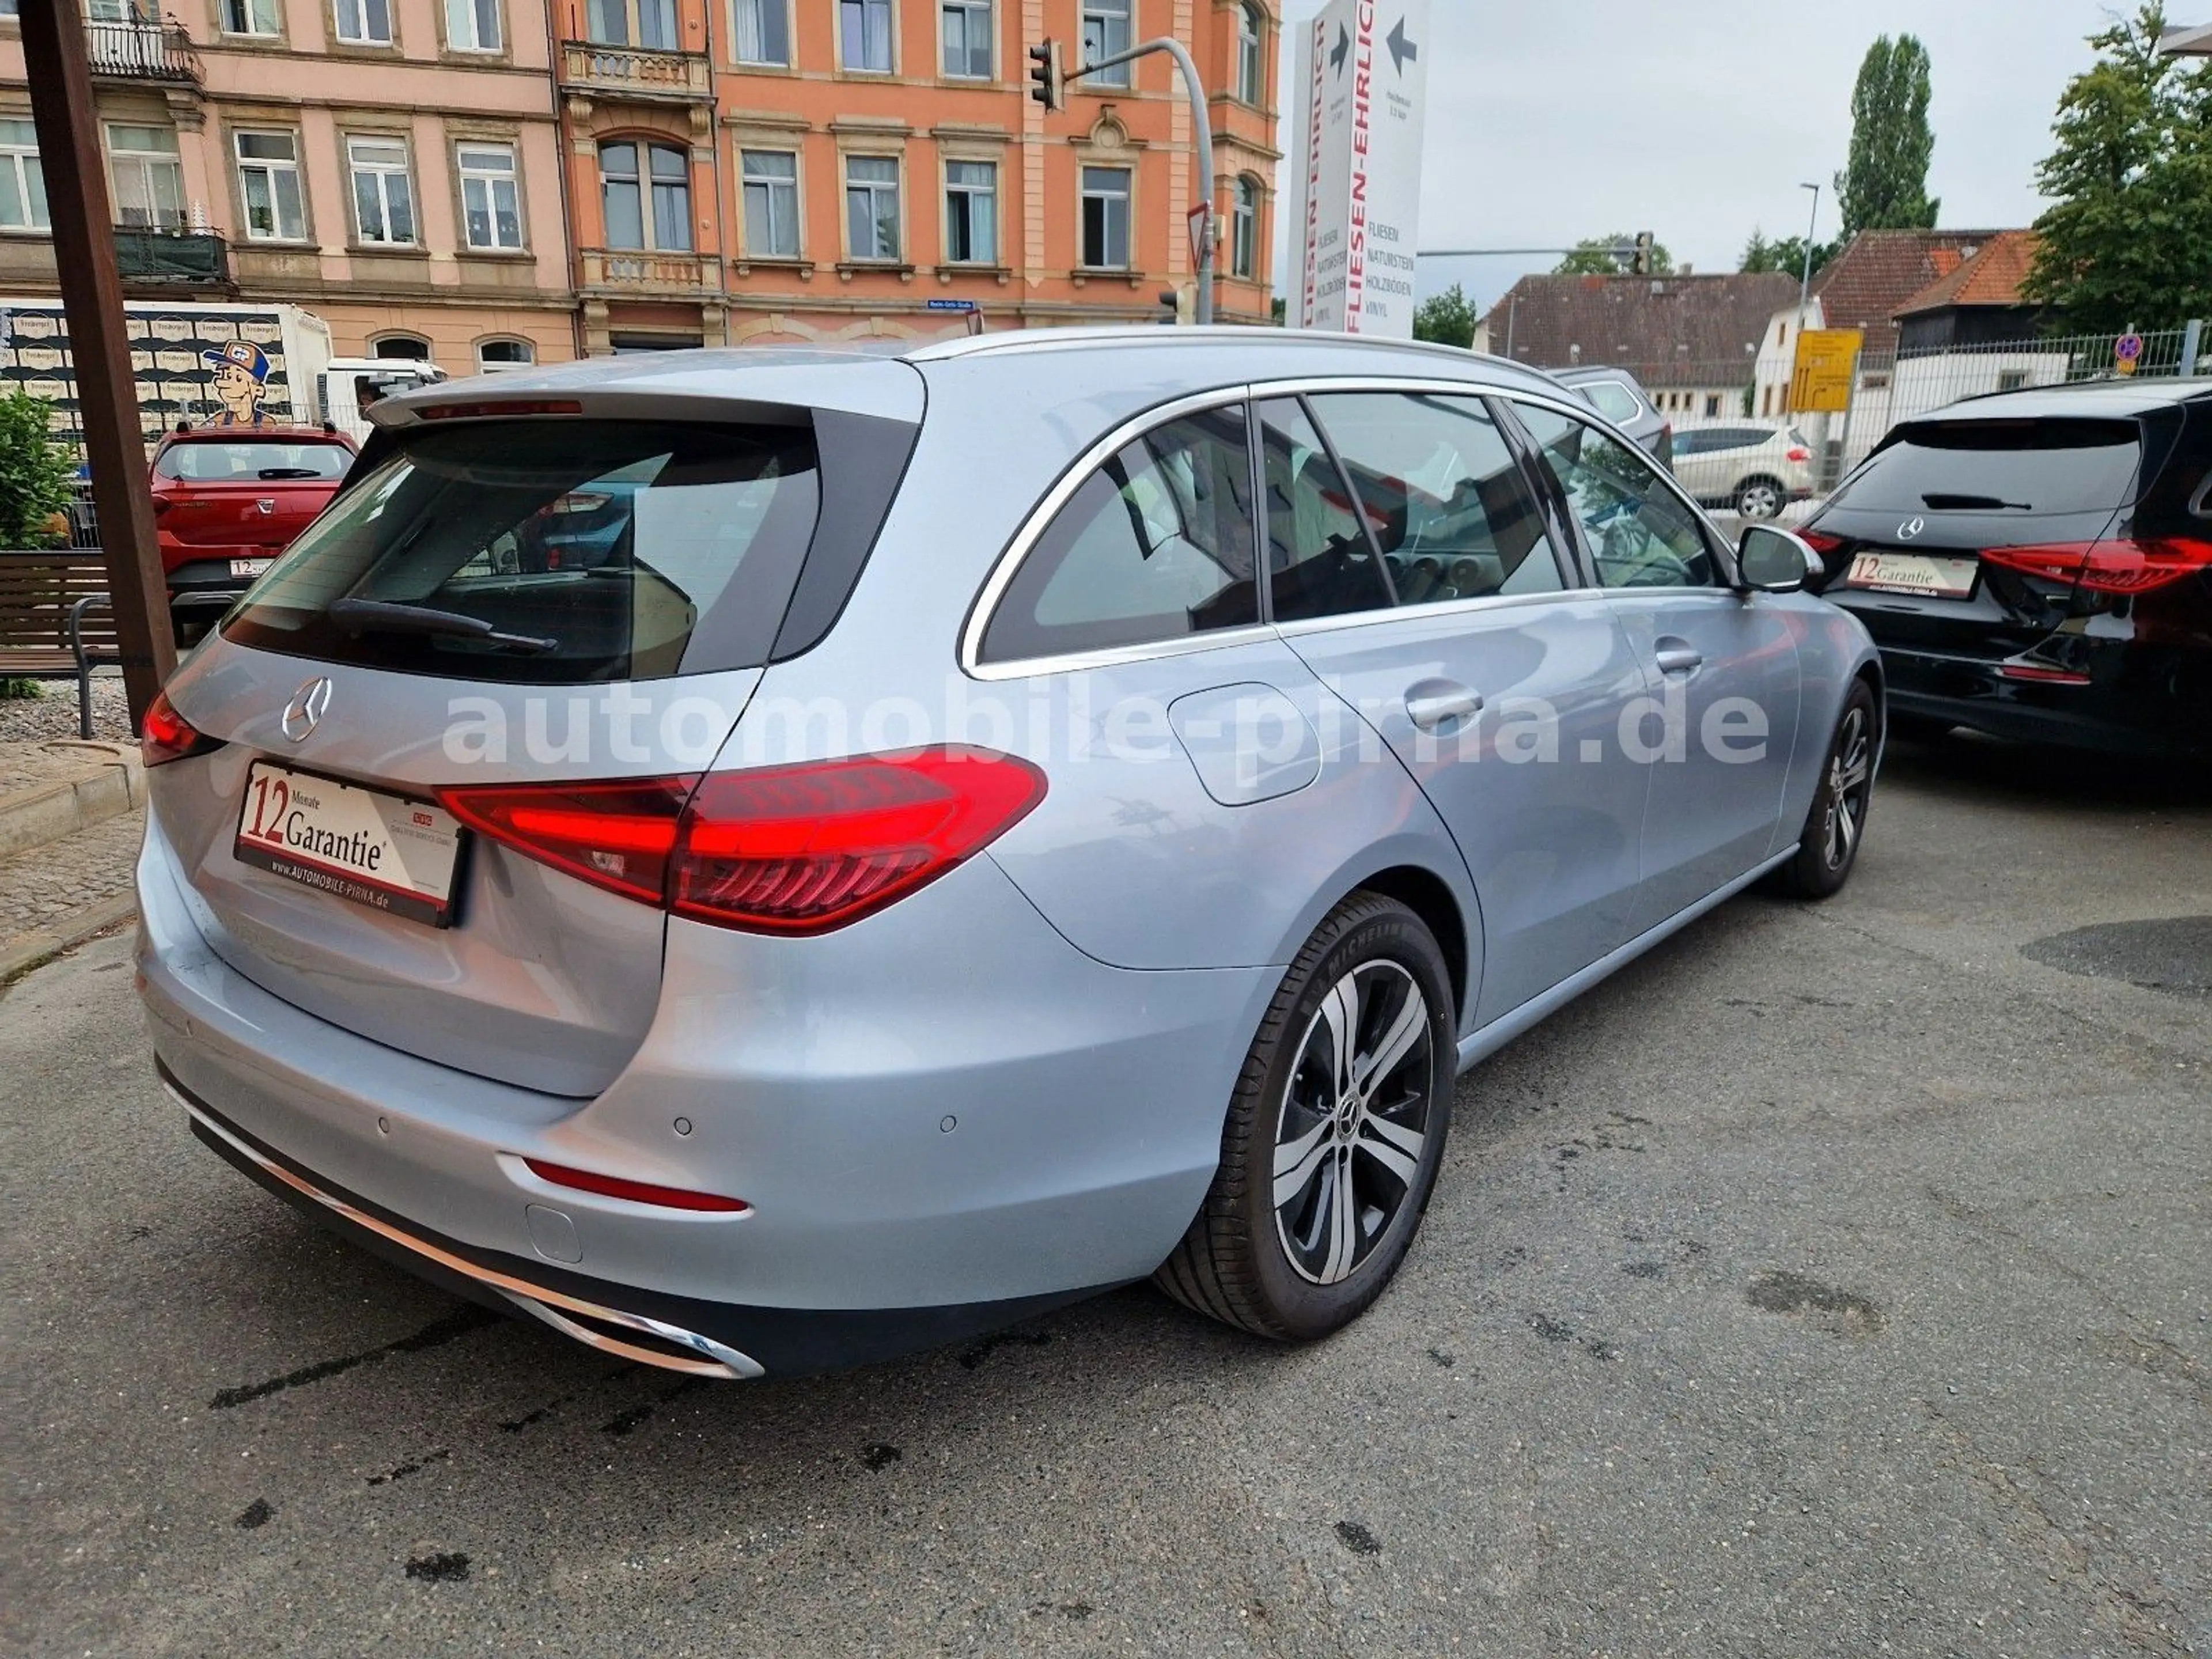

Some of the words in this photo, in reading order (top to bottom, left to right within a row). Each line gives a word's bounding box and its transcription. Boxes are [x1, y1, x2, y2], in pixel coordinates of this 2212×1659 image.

[1305, 20, 1324, 327] LIESEN-EHRLICH
[1368, 221, 1399, 242] FLIESEN
[1366, 276, 1411, 296] HOLZBÖDEN
[1365, 300, 1388, 317] VINYL
[236, 560, 252, 573] 12
[1855, 556, 1880, 579] 12
[1877, 568, 1933, 584] Garantie
[248, 775, 288, 844] 12
[291, 790, 320, 809] Monate
[286, 810, 381, 871] Garantie
[271, 859, 388, 908] www.AUTOMOBILE-PIRNA.de
